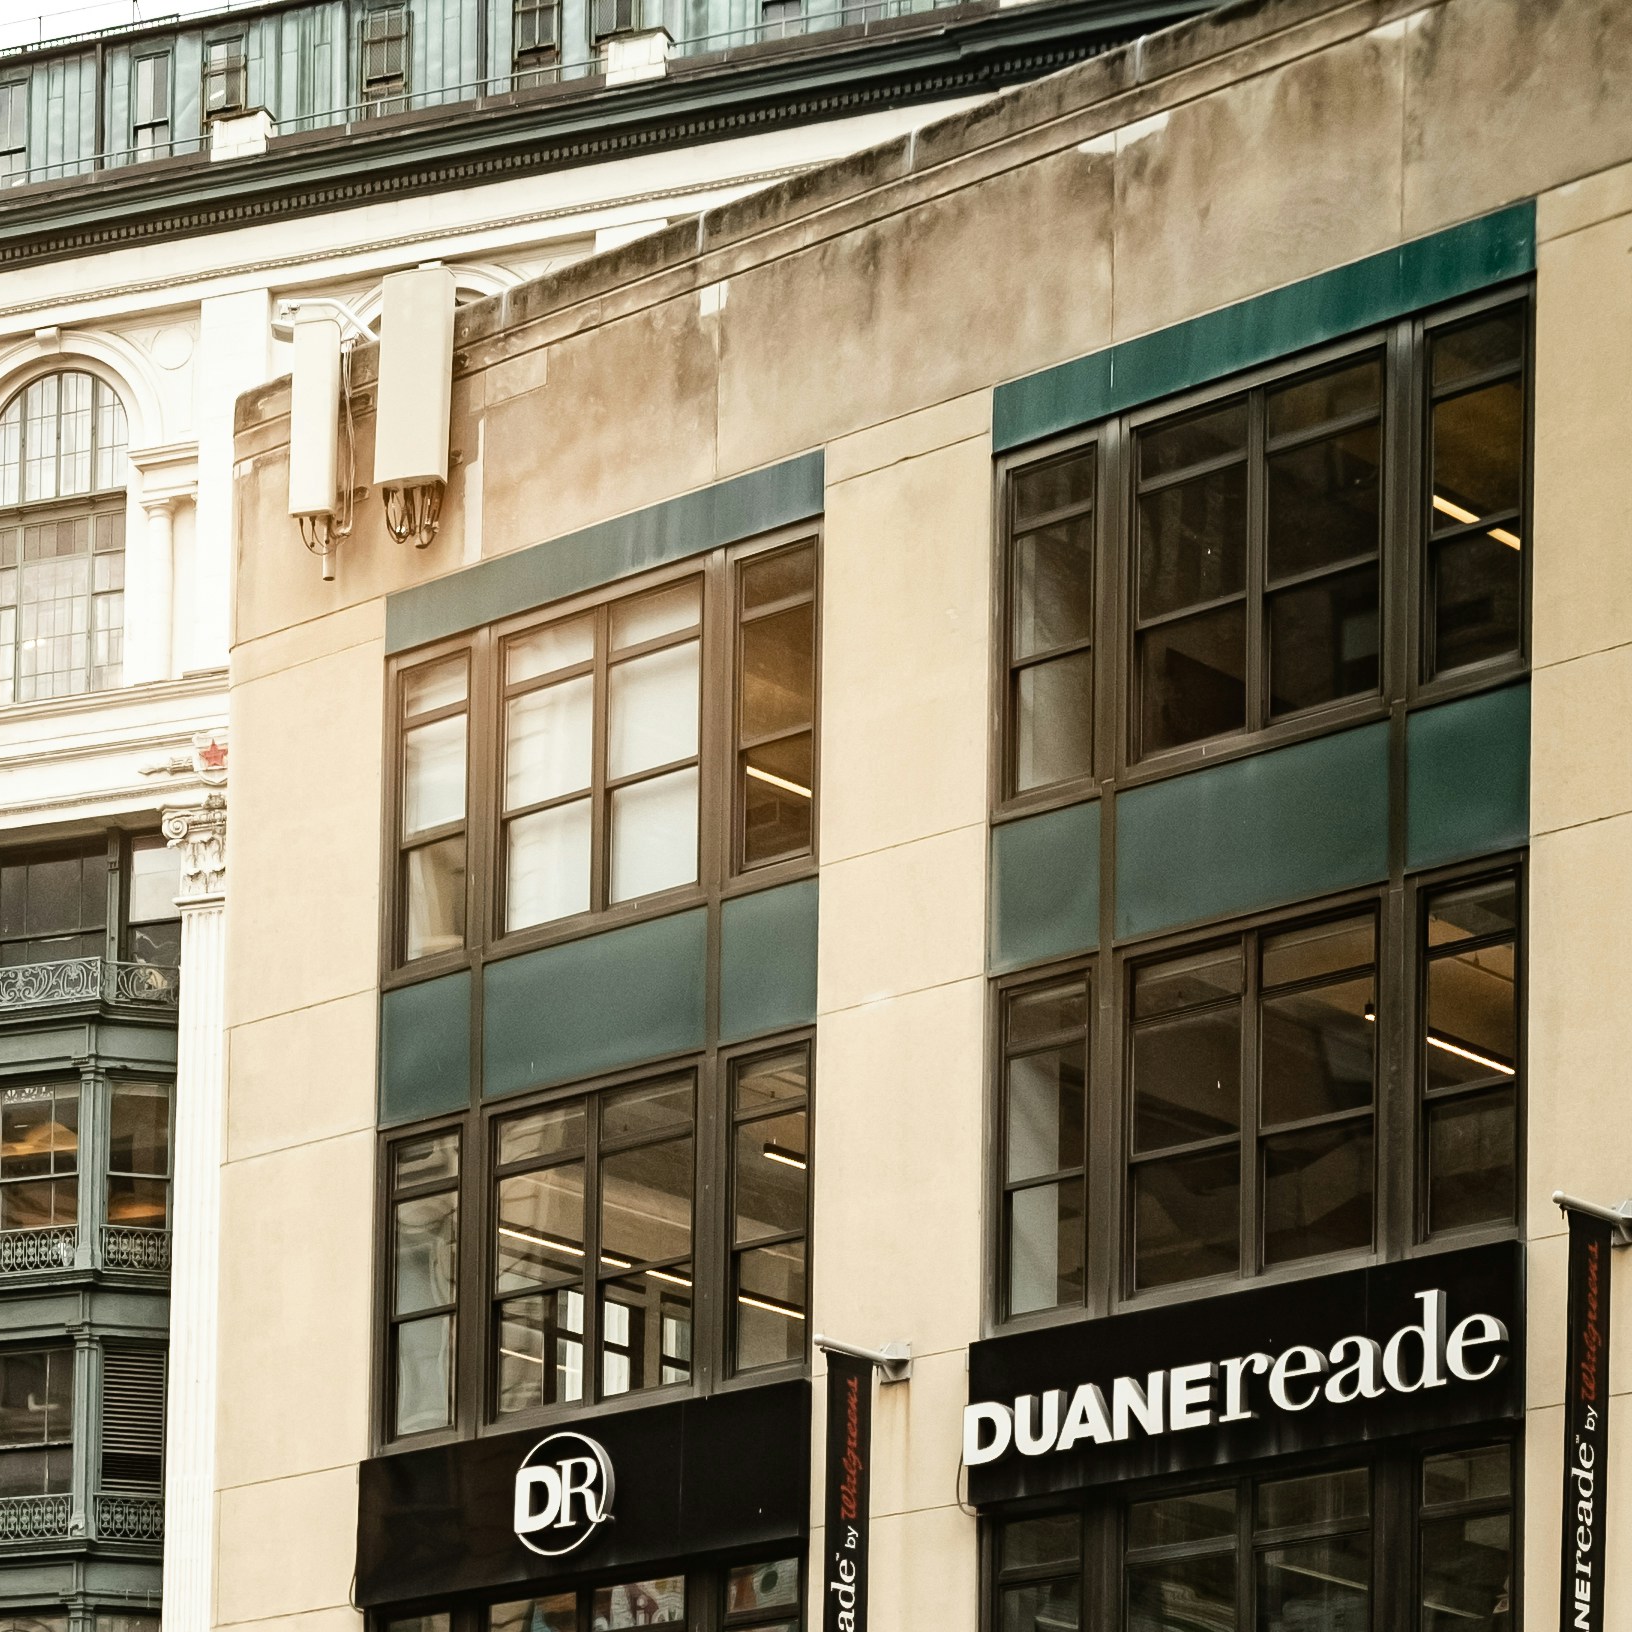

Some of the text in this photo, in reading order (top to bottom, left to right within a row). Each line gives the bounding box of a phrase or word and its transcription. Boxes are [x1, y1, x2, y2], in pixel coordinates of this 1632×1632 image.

[1581, 1240, 1602, 1402] Walgreens
[963, 1290, 1507, 1466] DUANEreade
[1585, 1405, 1598, 1431] by
[513, 1455, 615, 1537] DR
[840, 1376, 862, 1520] Walgreens
[845, 1526, 858, 1549] by
